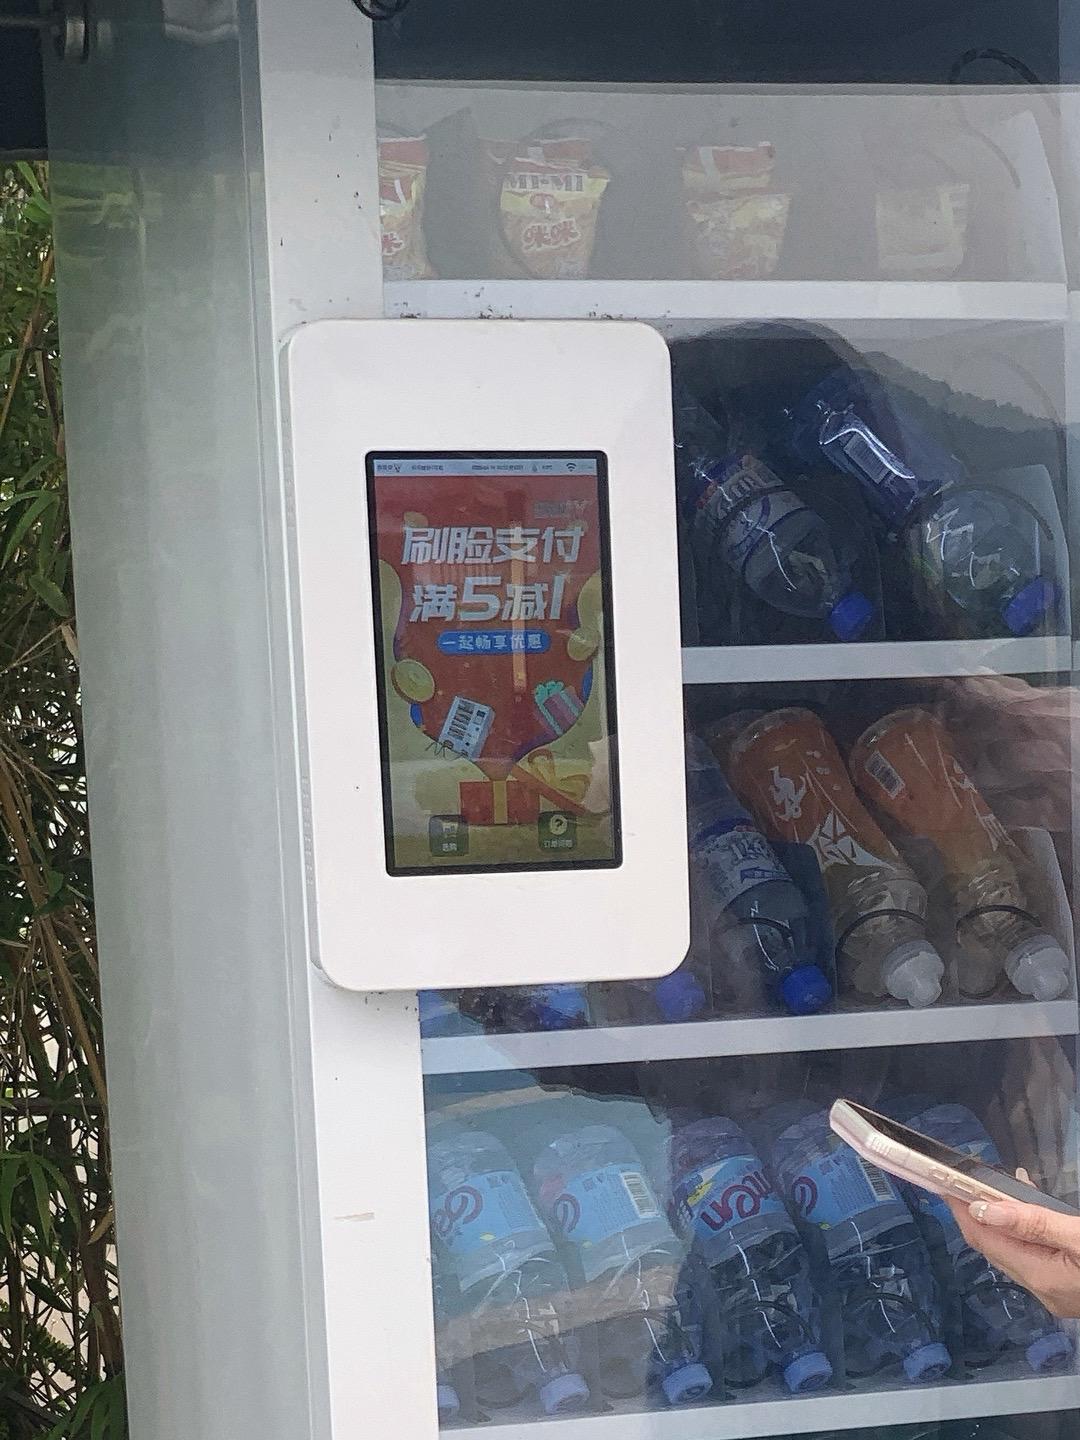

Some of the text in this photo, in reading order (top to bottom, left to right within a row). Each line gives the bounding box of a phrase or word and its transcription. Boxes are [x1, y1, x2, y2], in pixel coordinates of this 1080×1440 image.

[401, 526, 585, 565] 刷脸支付
[441, 633, 543, 651] 一起畅享优惠
